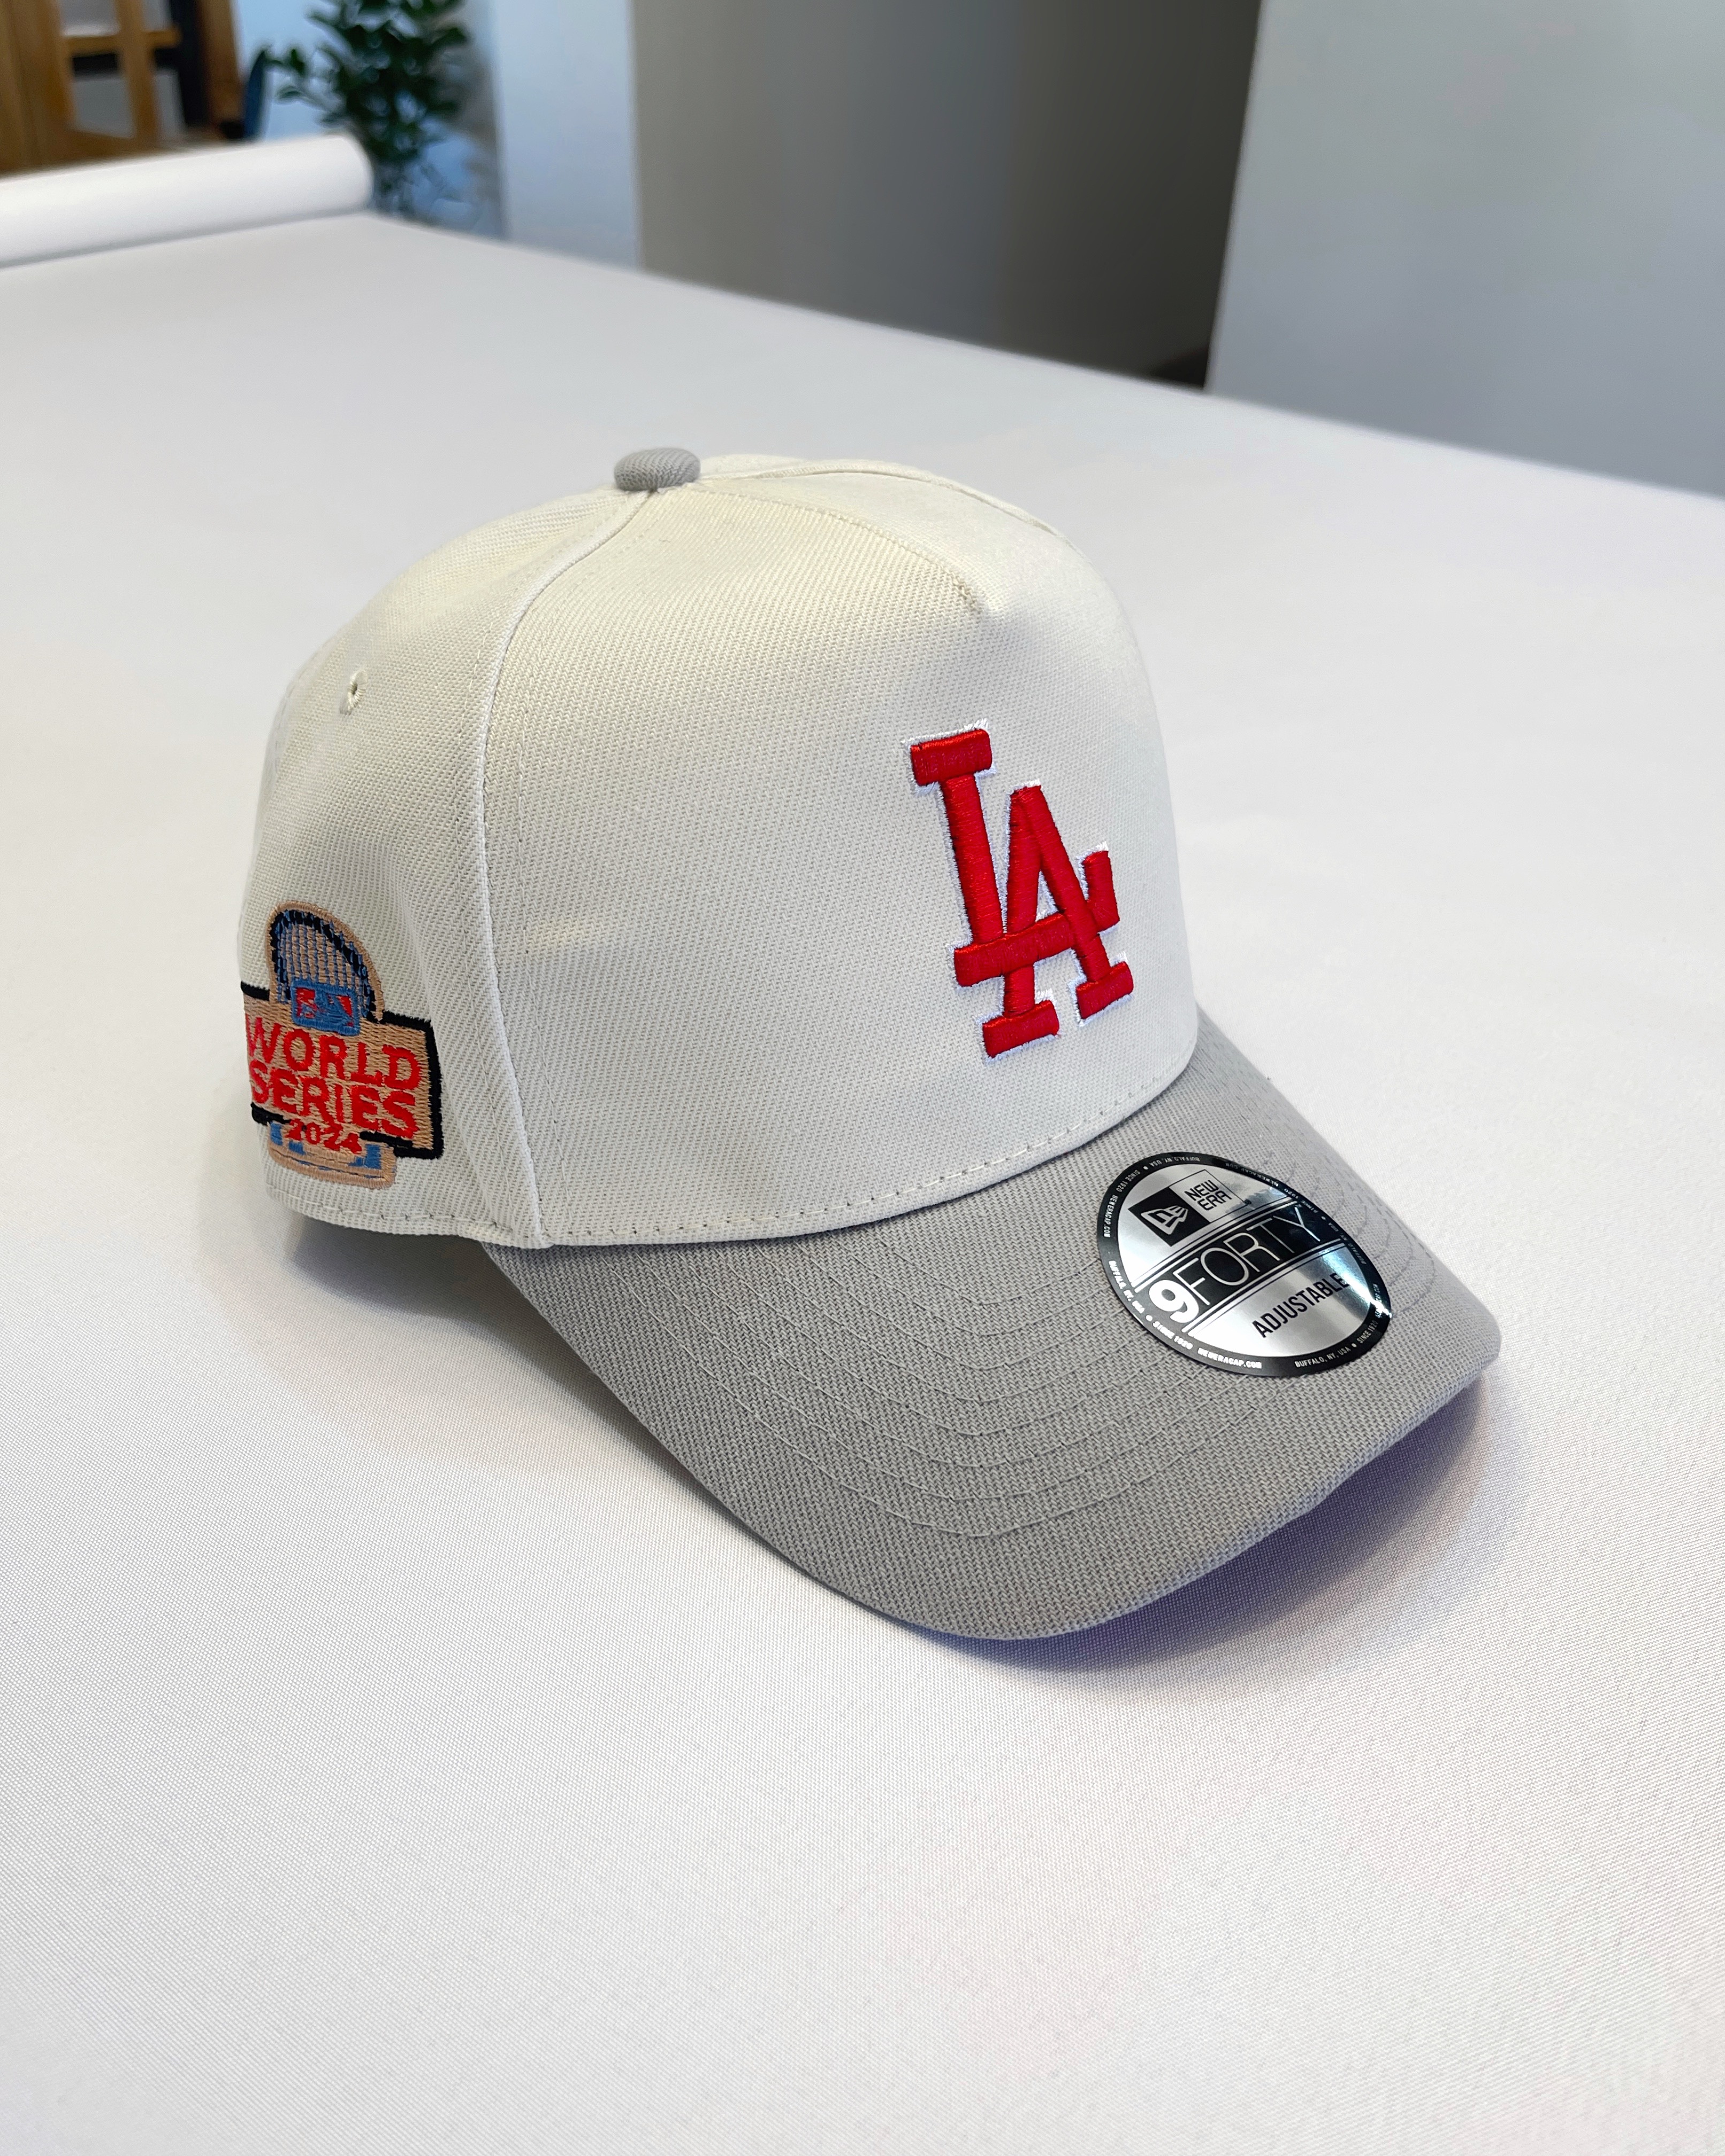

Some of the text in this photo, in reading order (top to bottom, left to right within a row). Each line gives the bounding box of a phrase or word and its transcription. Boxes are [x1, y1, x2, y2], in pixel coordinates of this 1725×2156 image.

[905, 723, 1135, 1060] LA
[246, 1014, 422, 1090] WORLD
[249, 1059, 419, 1139] SERIES
[284, 1118, 361, 1153] 2024
[1184, 1180, 1219, 1201] NEW
[1197, 1190, 1232, 1211] ERA
[1148, 1206, 1321, 1323] 9FORTY
[1251, 1272, 1350, 1338] ADJUSTABLE
[1294, 1356, 1327, 1367] BUFFALO,
[1338, 1346, 1352, 1356] USA
[1356, 1329, 1371, 1344] SINCE
